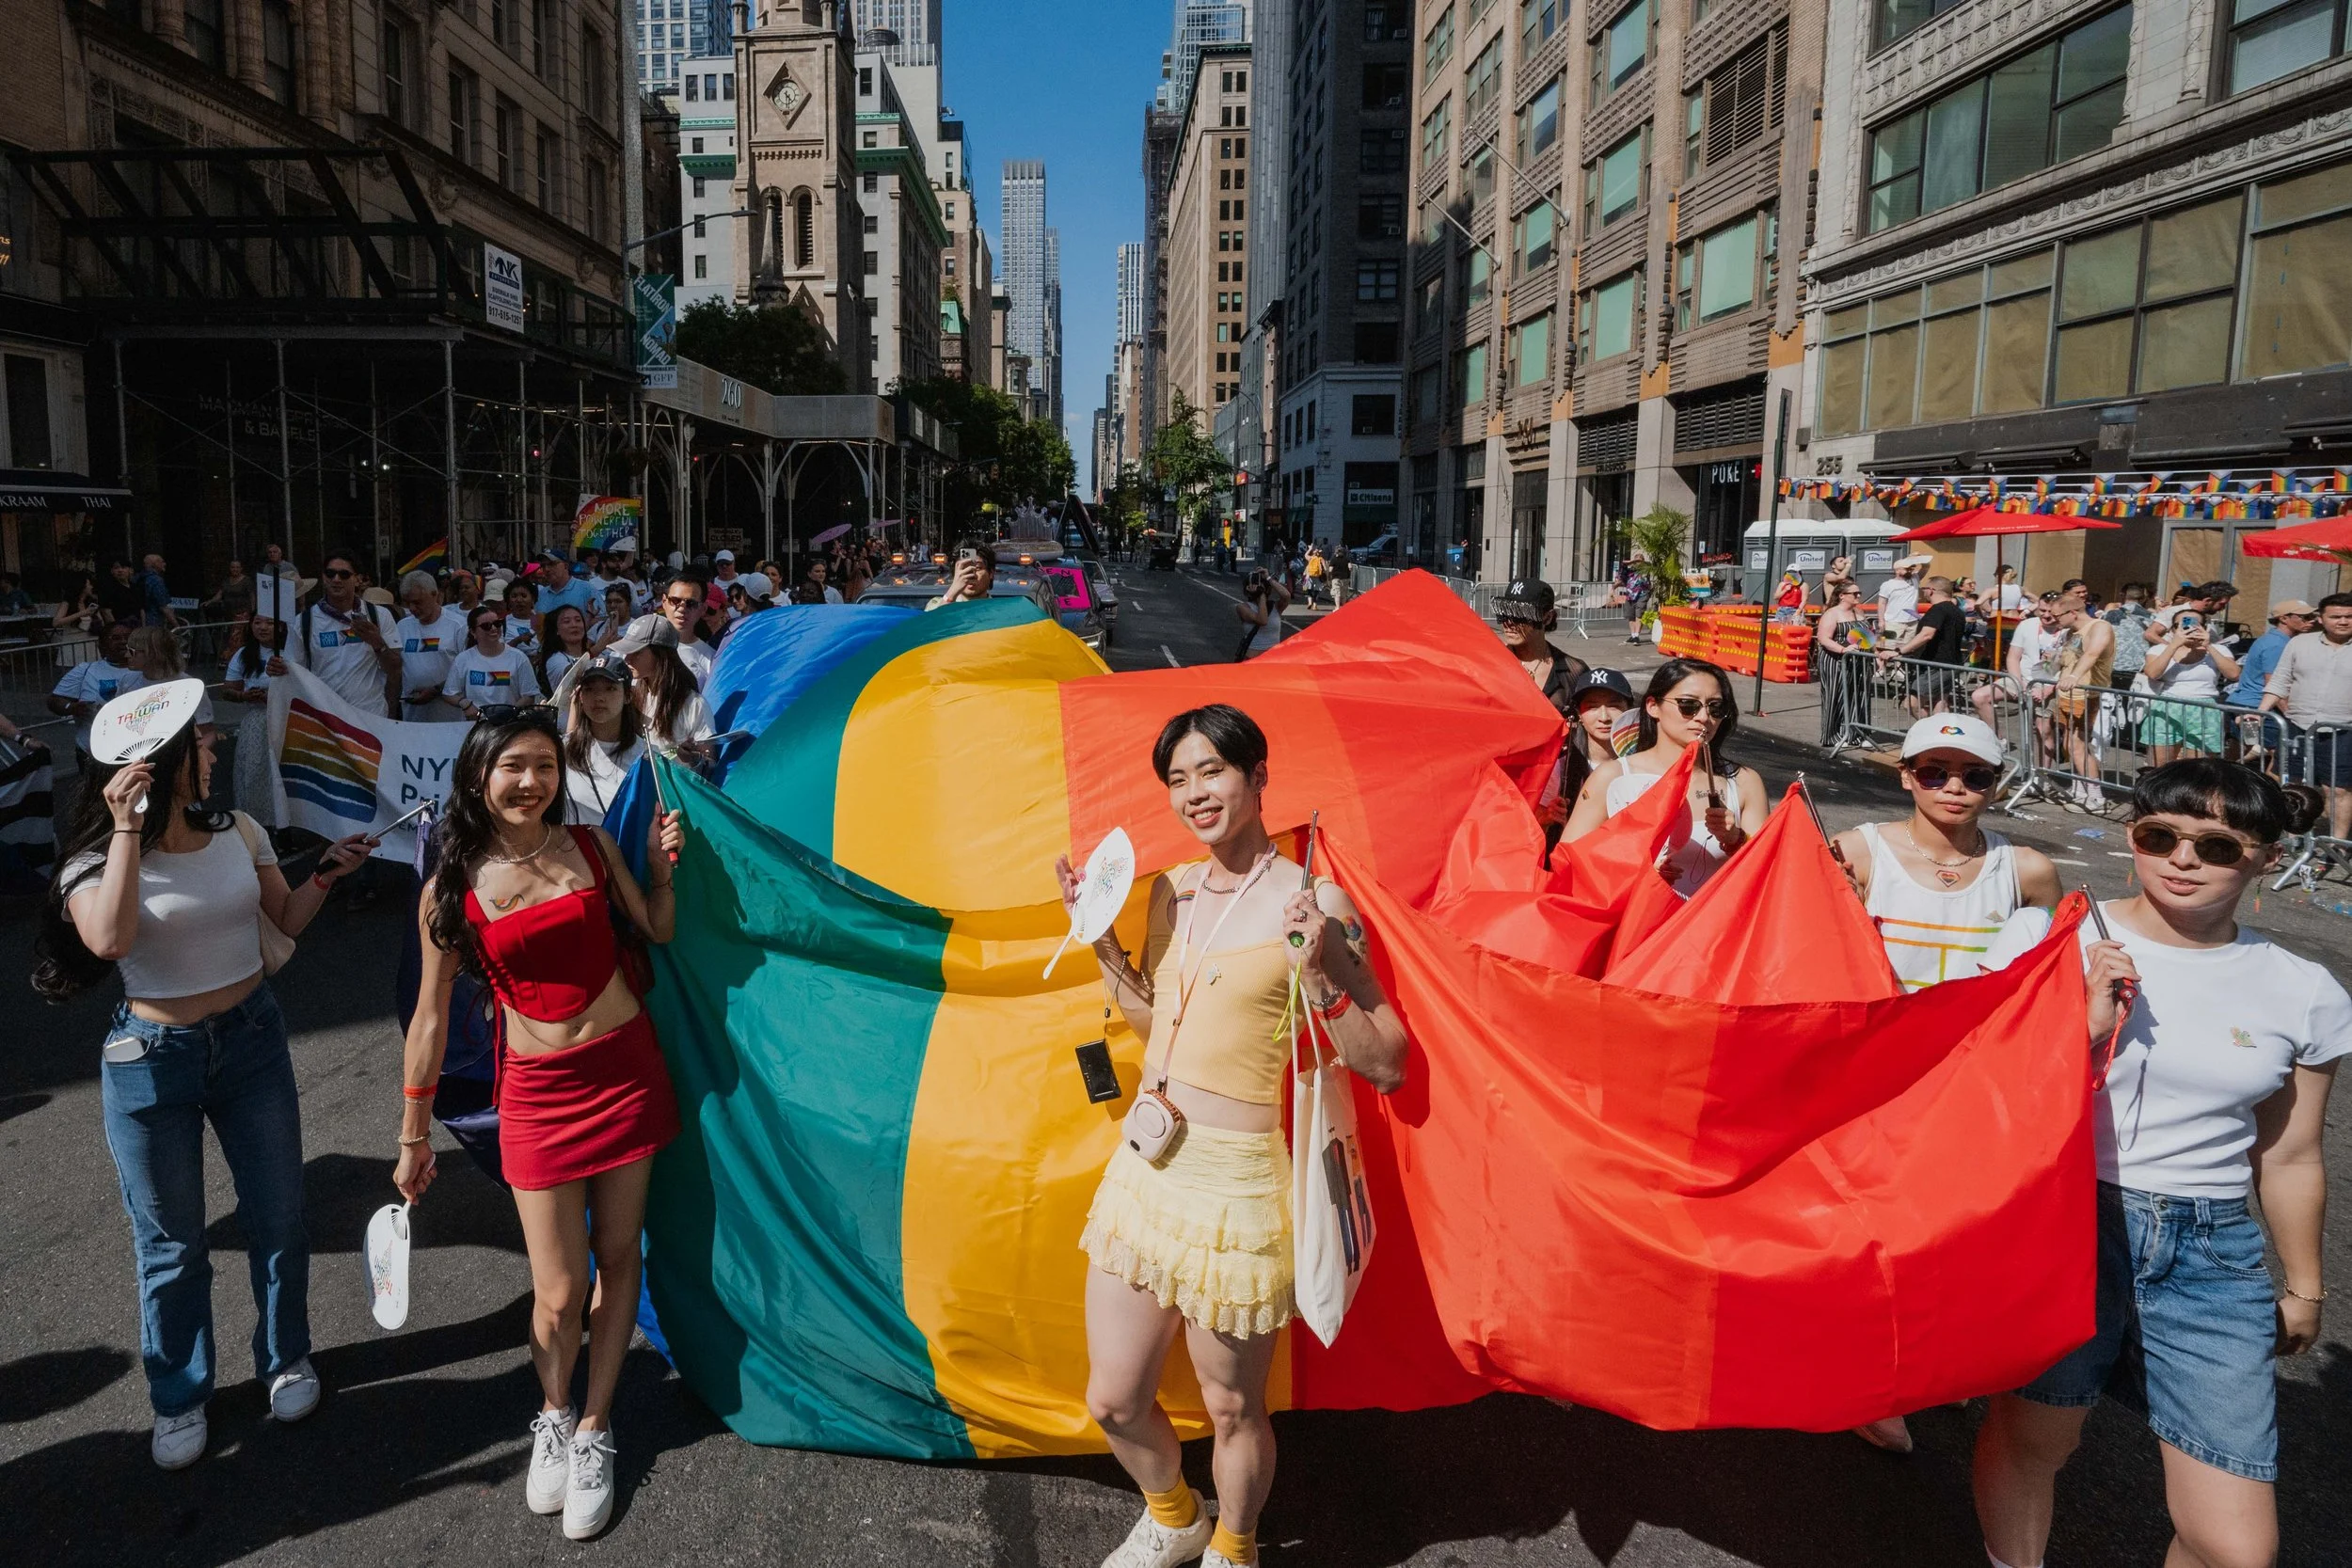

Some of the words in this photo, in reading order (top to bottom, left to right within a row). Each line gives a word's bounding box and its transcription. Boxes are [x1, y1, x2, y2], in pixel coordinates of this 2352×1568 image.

[634, 275, 671, 313] FLATIRON
[641, 334, 672, 366] NOMAD
[654, 373, 674, 382] GFP
[722, 378, 740, 408] 260
[260, 422, 316, 442] BAELS
[1817, 455, 1843, 476] 255
[81, 496, 112, 508] THAI
[1359, 493, 1392, 502] Citizens
[595, 502, 629, 516] MORE
[579, 514, 633, 526] POWERFUL
[579, 526, 629, 539] TOGETHER
[1511, 581, 1524, 594] NY
[596, 657, 605, 668] B
[1590, 670, 1608, 684] NY
[117, 700, 170, 725] TAIWAN
